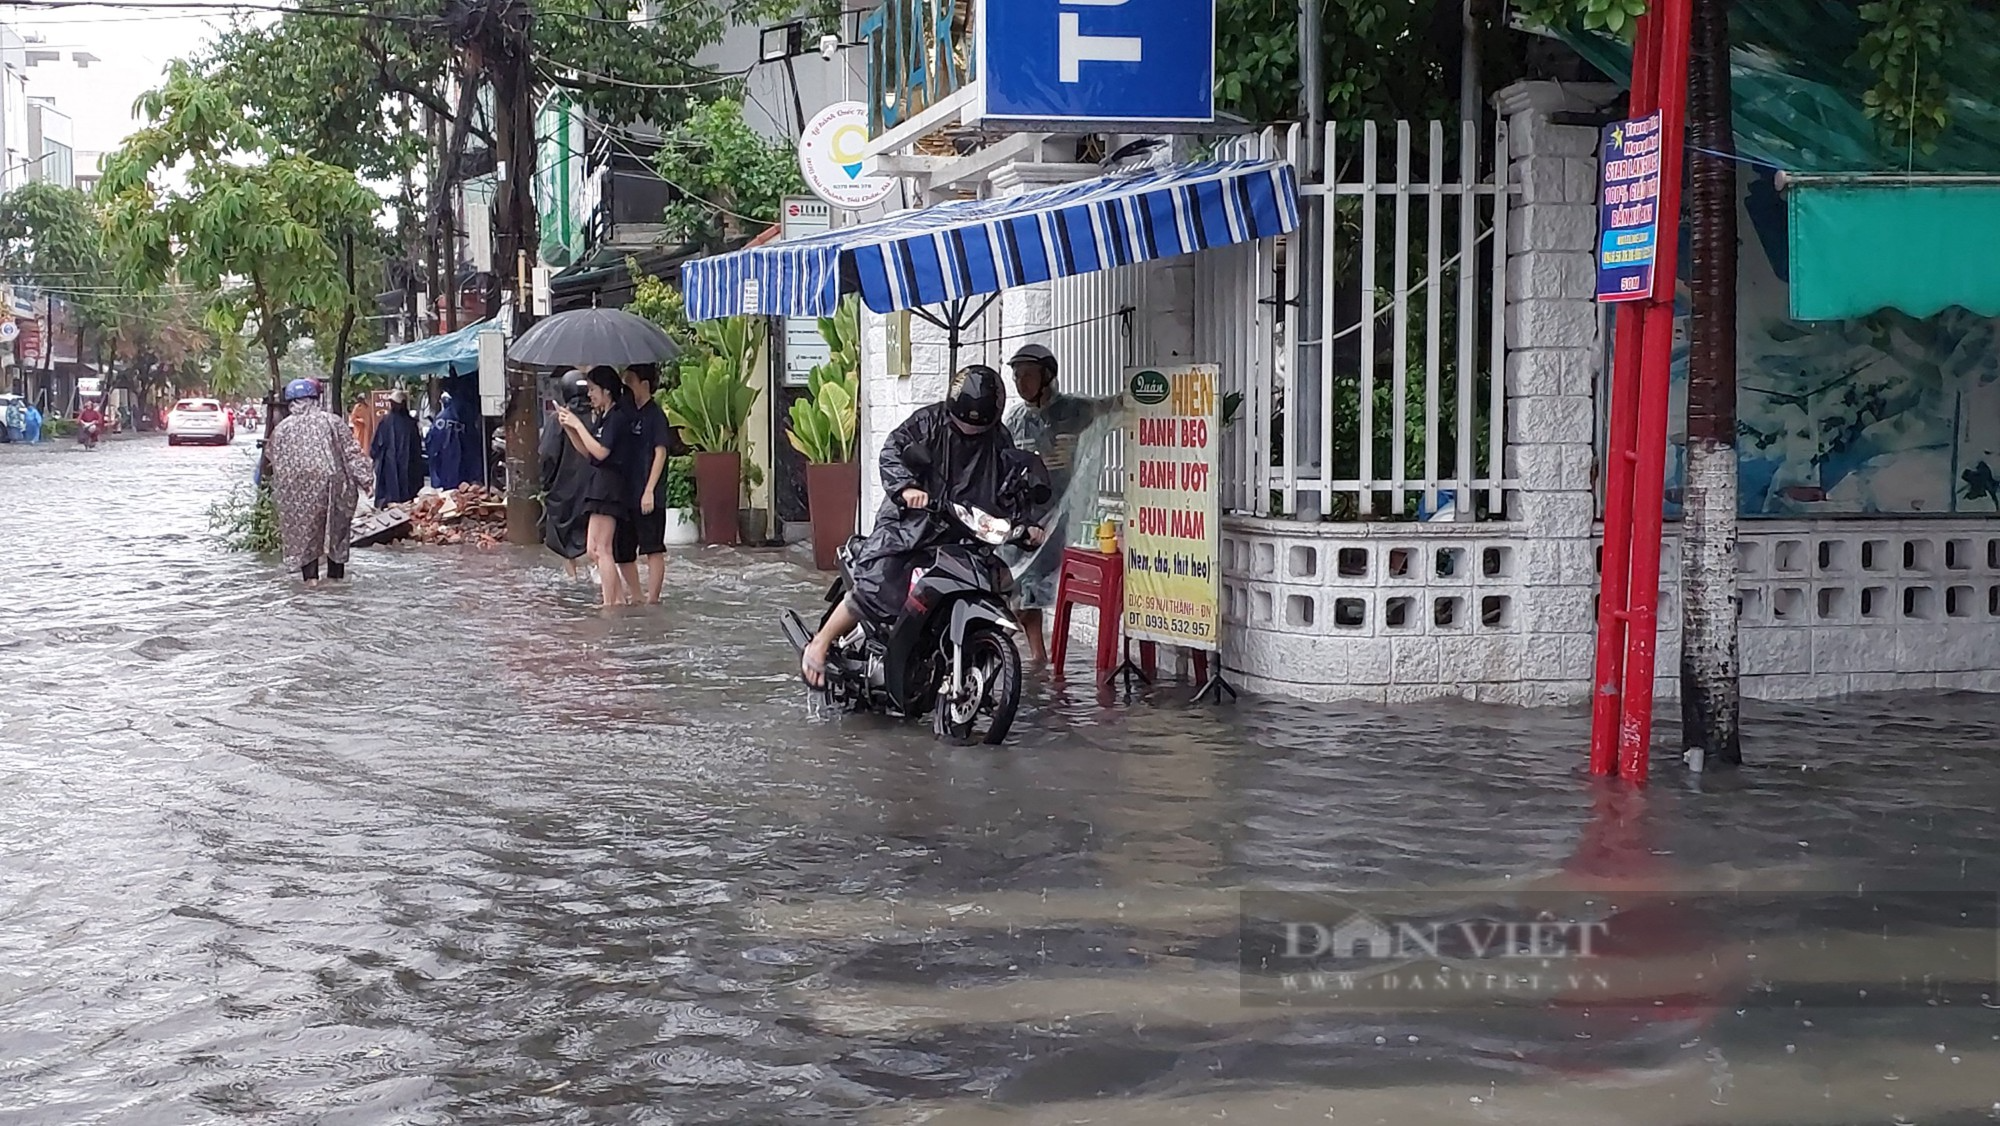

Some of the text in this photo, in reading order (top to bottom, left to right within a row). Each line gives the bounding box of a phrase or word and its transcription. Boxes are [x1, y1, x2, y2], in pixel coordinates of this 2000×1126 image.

[1606, 160, 1628, 182] STAR
[1136, 375, 1164, 393] Quán
[1139, 411, 1176, 447] BÁNH
[1139, 454, 1176, 490] BÁNH
[1139, 498, 1205, 540] BÚN MẮM
[1145, 614, 1169, 630] 0935
[1171, 618, 1189, 634] 532
[1192, 622, 1211, 637] 957
